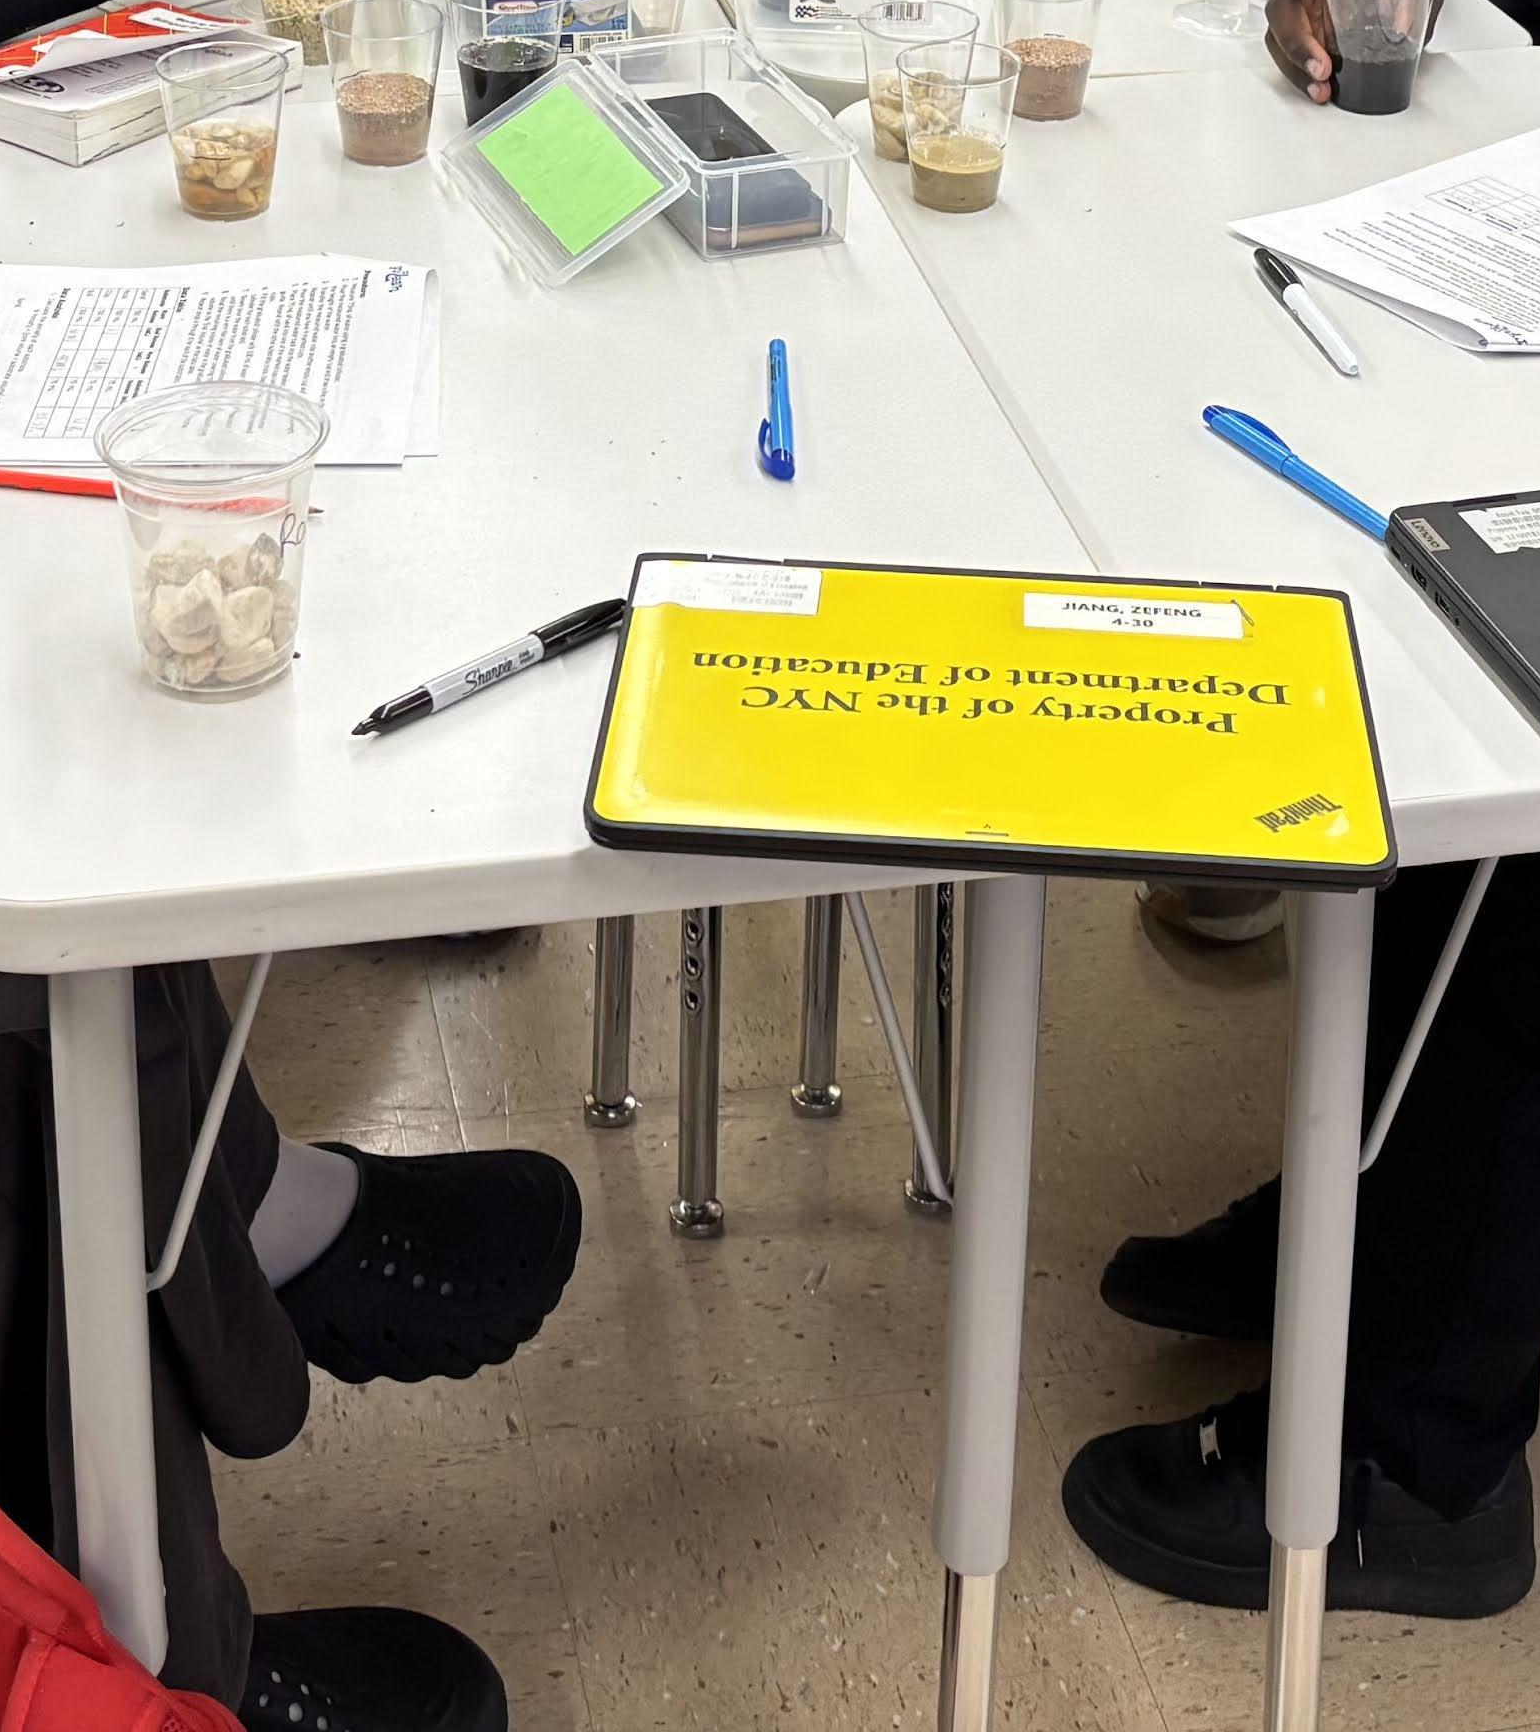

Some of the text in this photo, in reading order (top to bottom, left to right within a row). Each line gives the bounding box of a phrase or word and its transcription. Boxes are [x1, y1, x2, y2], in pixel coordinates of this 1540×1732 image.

[461, 656, 514, 696] Sharpie
[692, 649, 1292, 706] Department of Education
[741, 684, 1238, 735] Property of the NYC
[1253, 792, 1343, 834] ThinkPad
